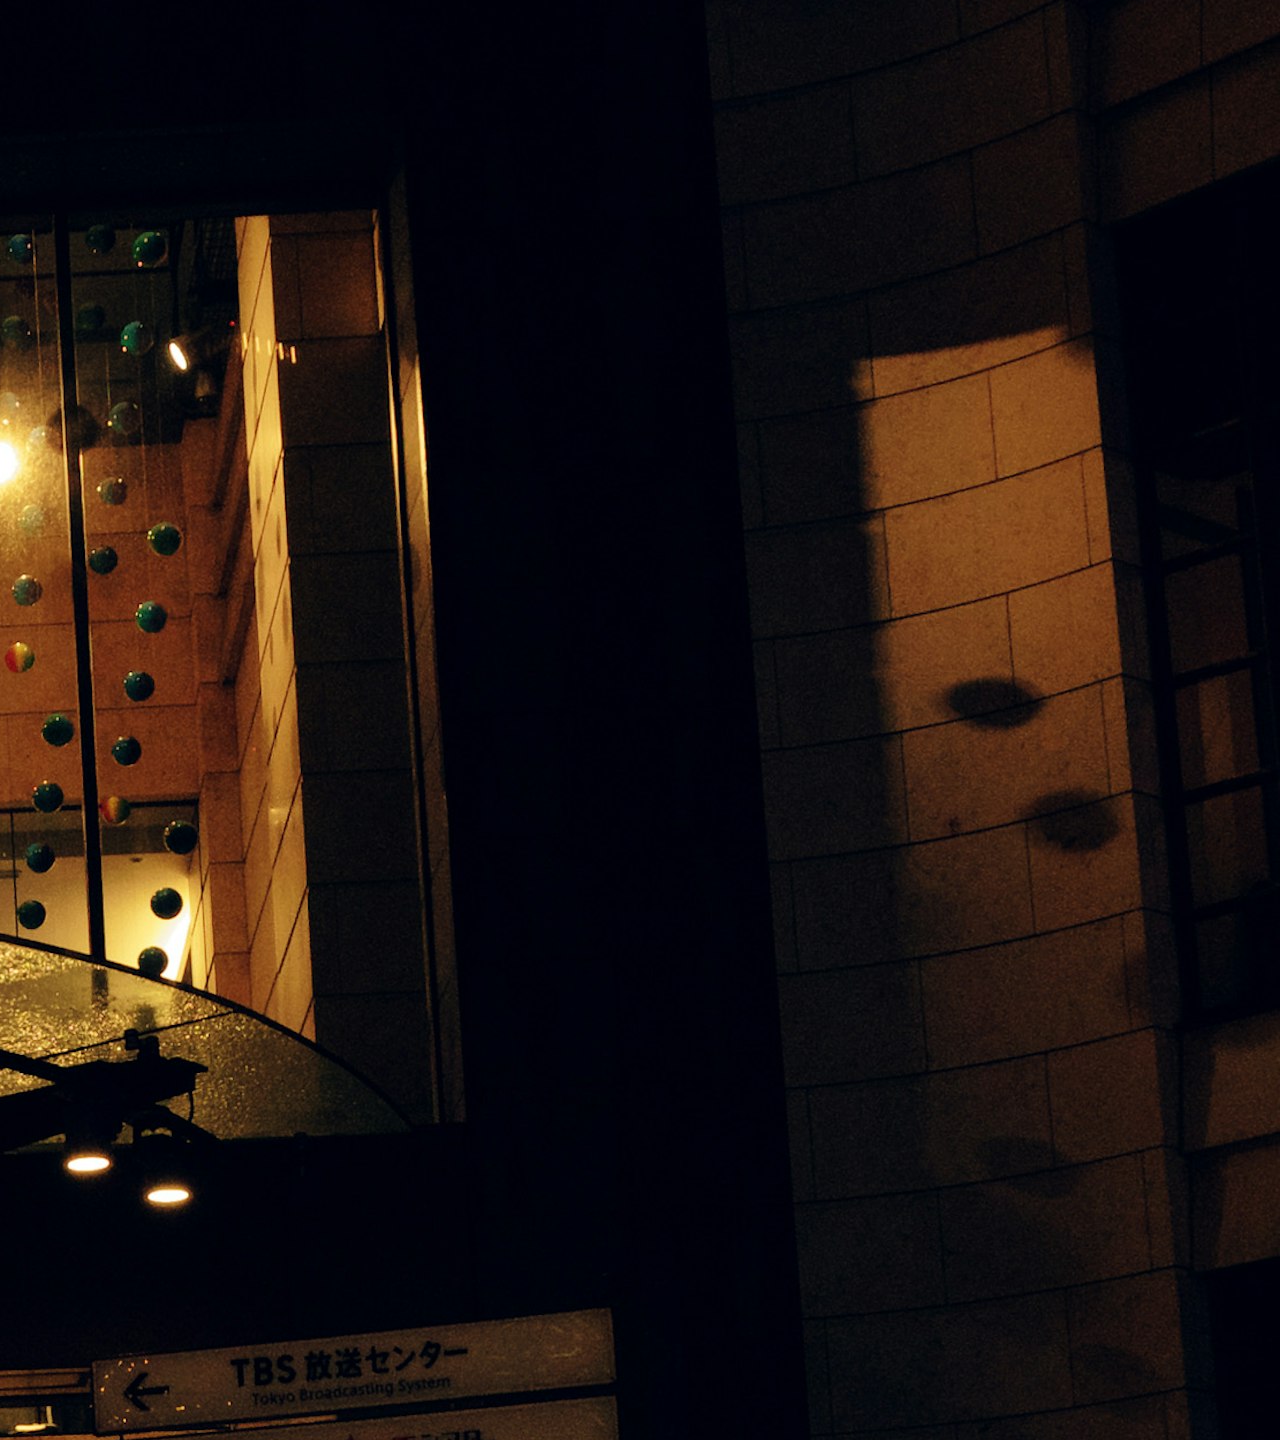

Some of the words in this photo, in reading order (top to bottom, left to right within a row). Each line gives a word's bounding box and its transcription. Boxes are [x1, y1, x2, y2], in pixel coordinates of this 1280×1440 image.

[231, 1355, 296, 1386] TBS
[306, 1341, 467, 1381] 放送センター
[251, 1391, 296, 1407] Tokyo
[300, 1382, 394, 1401] Broadcasting
[397, 1375, 451, 1394] System
